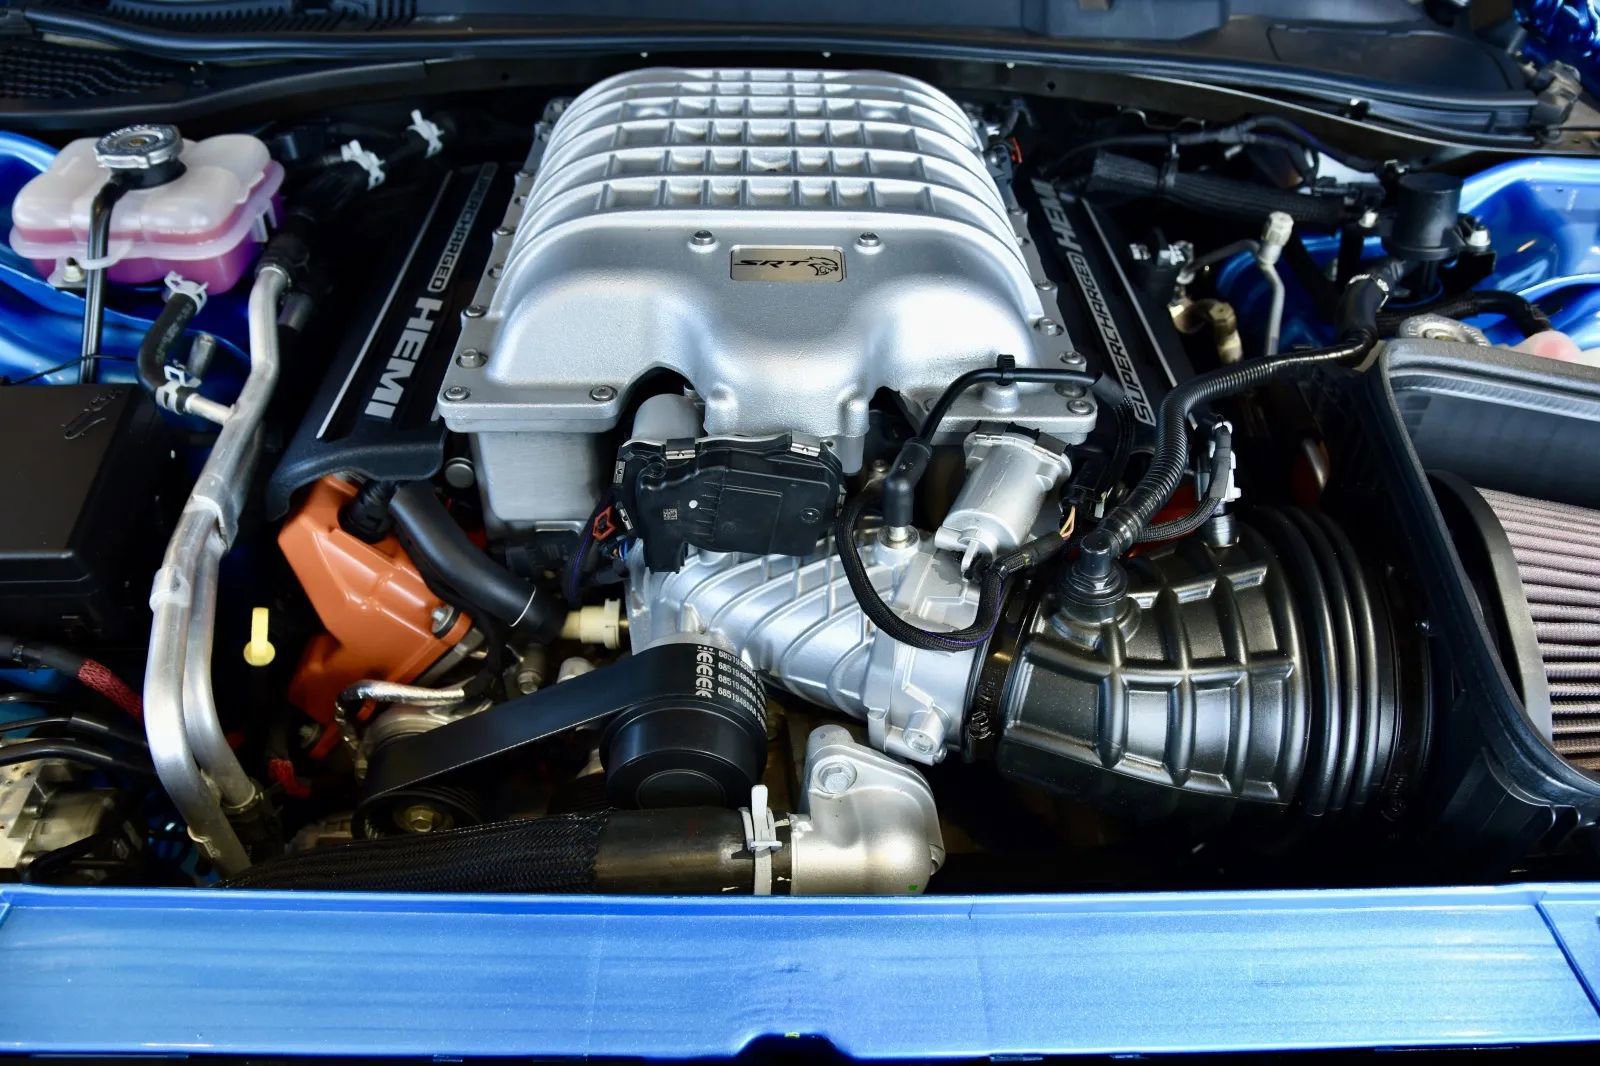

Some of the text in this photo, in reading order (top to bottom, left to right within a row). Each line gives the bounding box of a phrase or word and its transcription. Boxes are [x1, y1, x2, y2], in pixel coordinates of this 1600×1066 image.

[733, 260, 808, 268] SRT
[364, 297, 444, 420] HEMI
[1070, 254, 1154, 425] SUPERCHARGED
